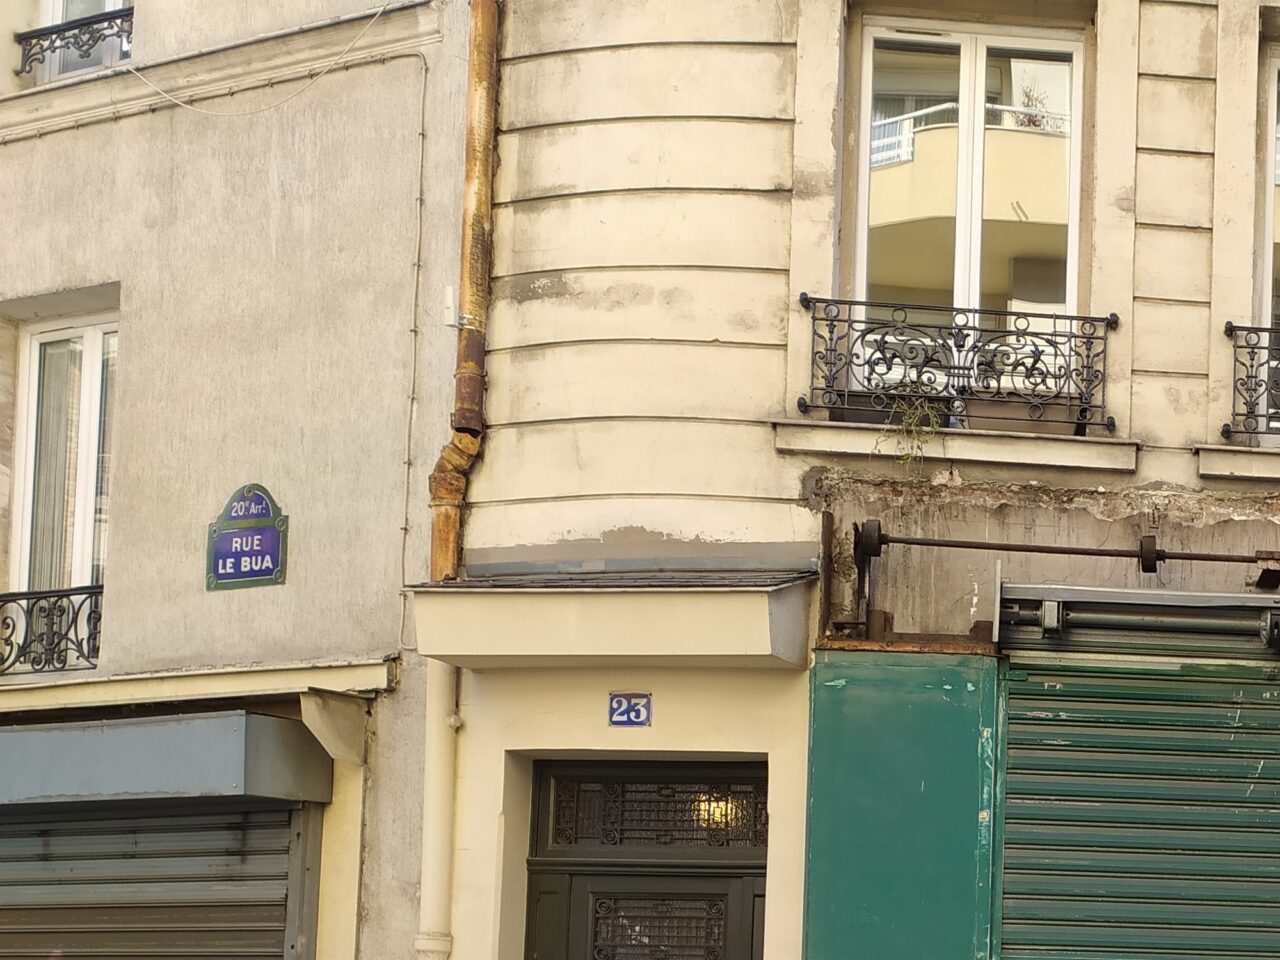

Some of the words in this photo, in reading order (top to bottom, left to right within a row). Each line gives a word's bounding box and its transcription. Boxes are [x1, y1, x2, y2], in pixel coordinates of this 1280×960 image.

[231, 535, 262, 553] RUE
[218, 558, 235, 574] LE
[240, 554, 274, 572] BUA
[611, 696, 648, 722] 23
